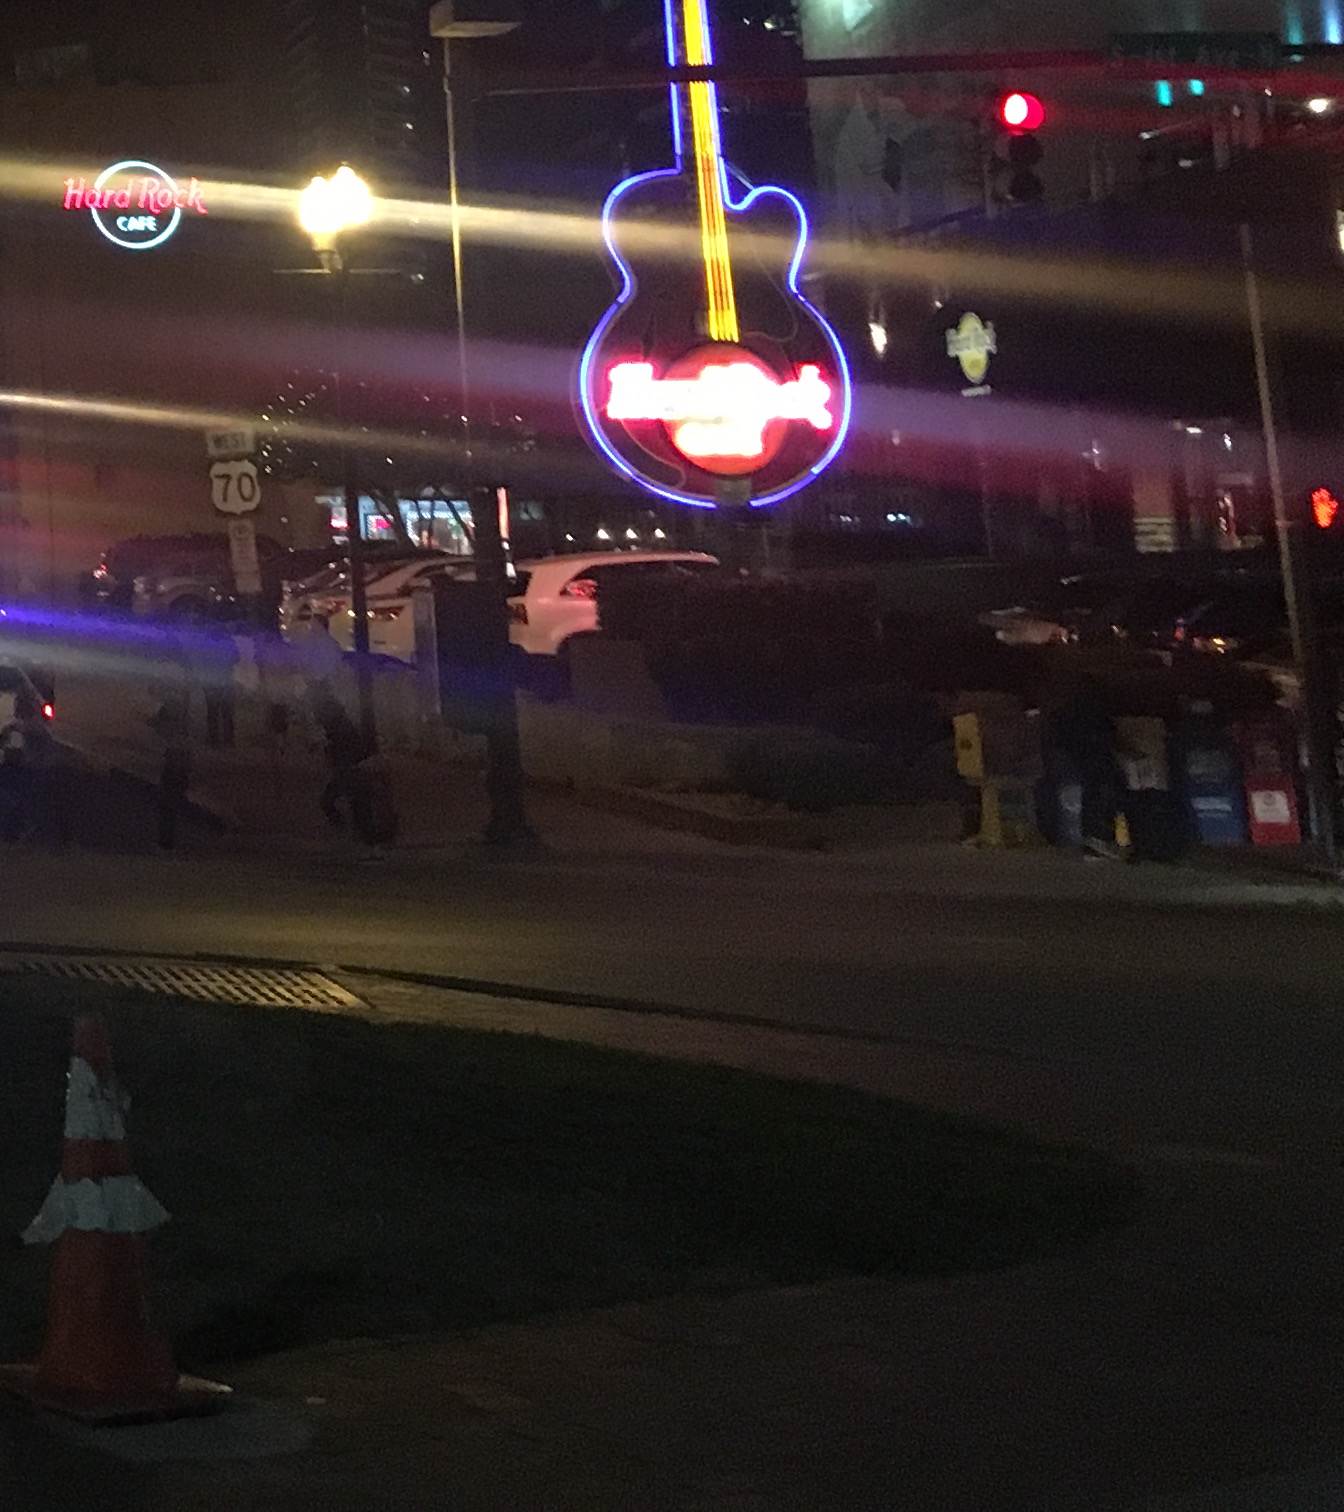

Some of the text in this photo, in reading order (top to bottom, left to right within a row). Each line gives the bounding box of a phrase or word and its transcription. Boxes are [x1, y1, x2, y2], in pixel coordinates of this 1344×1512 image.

[64, 174, 208, 215] Hard Rock
[116, 216, 158, 232] CAFE
[214, 473, 256, 502] 70
